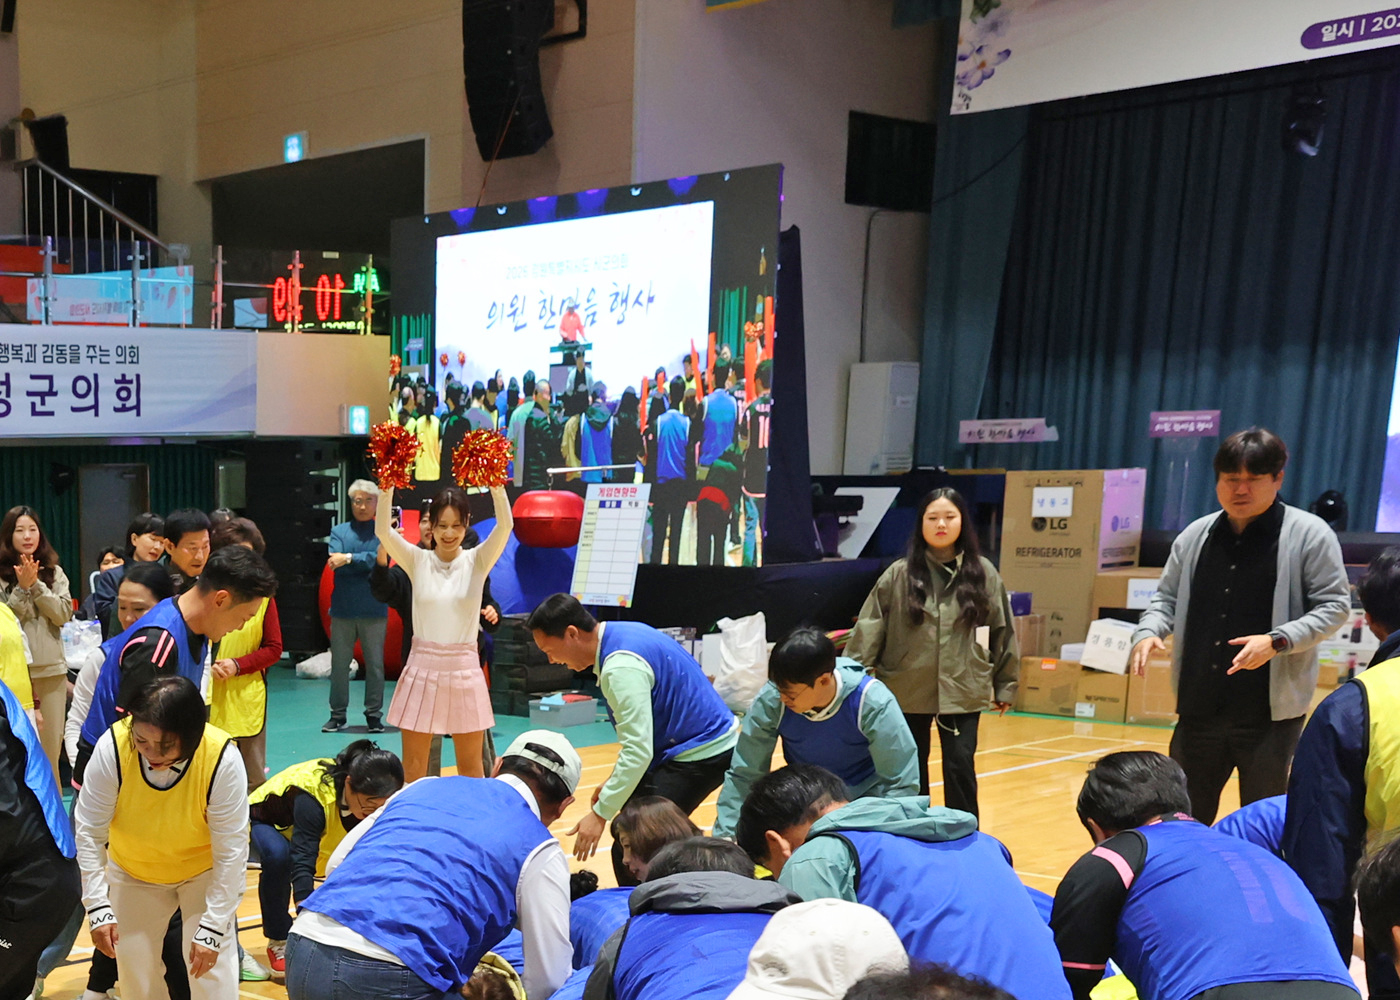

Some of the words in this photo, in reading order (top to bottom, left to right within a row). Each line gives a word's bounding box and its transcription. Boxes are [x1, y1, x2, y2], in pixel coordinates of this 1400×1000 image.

[1321, 20, 1355, 42] 일시
[486, 294, 527, 332] 의원
[609, 281, 656, 325] 행사
[42, 342, 81, 364] 감동을
[86, 343, 110, 364] 주는
[115, 344, 140, 364] 의회
[1050, 519, 1068, 530] LG
[1120, 517, 1131, 530] LG
[1016, 547, 1082, 558] REFRIGERATOR
